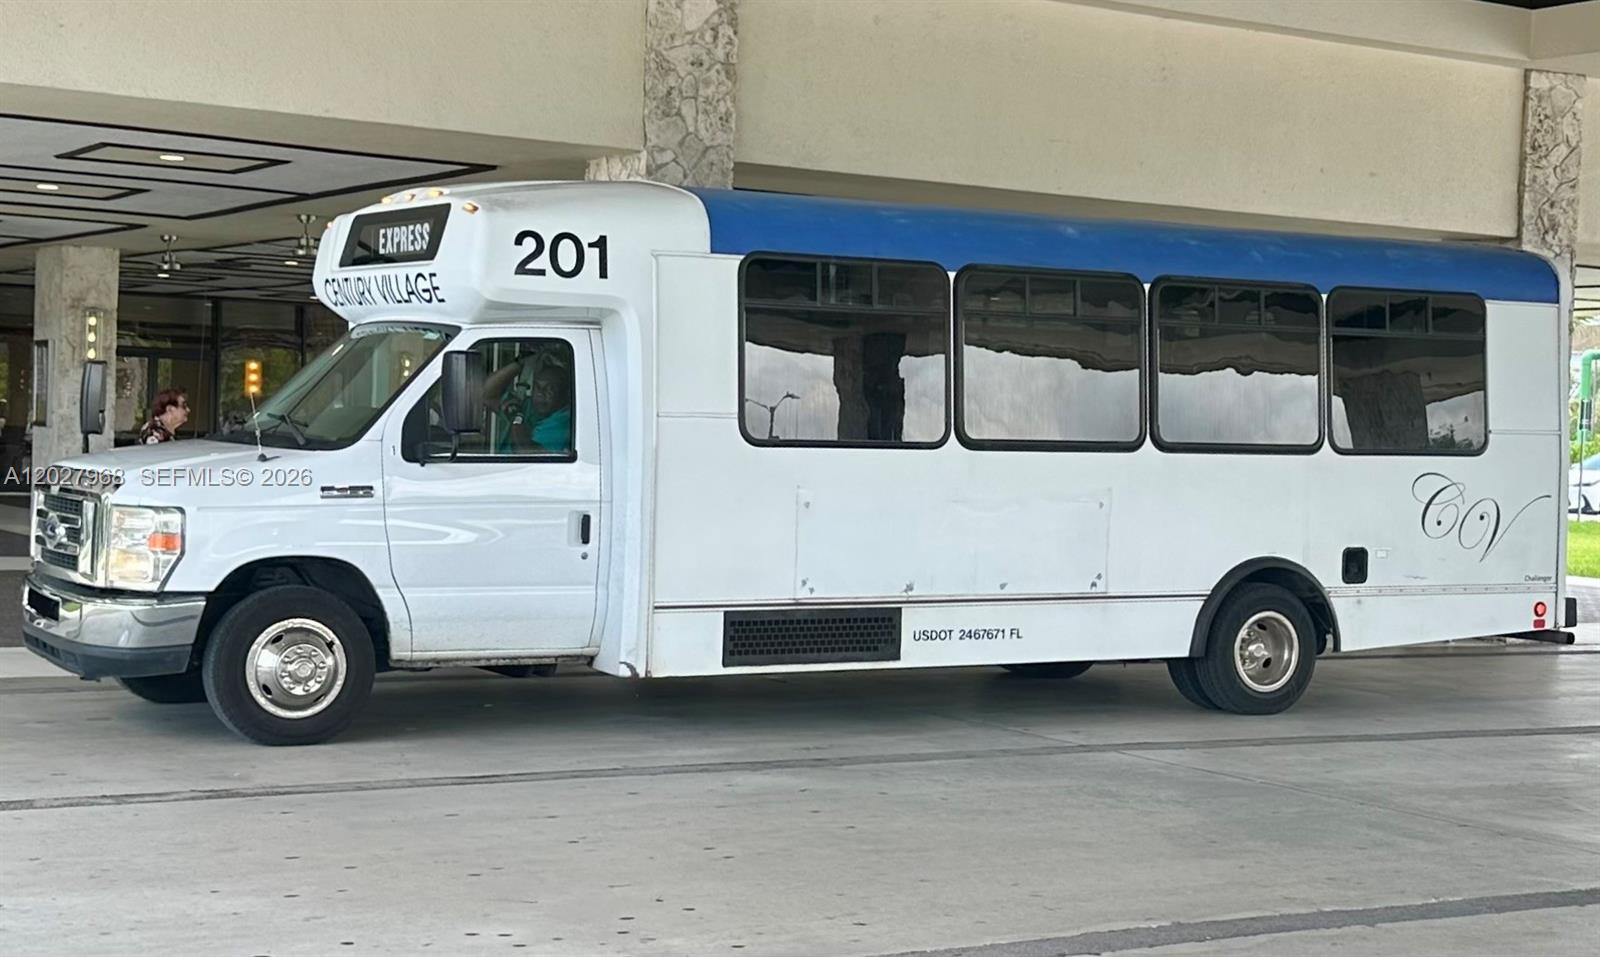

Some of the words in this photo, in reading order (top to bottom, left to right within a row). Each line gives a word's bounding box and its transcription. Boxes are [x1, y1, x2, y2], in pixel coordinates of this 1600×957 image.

[378, 222, 430, 255] EXPRESS
[513, 229, 609, 280] 201
[324, 276, 374, 307] CENTURY
[373, 272, 446, 304] VILLAGE
[913, 629, 954, 641] USDOT
[958, 628, 1006, 641] 2467671
[1009, 628, 1023, 639] FL
